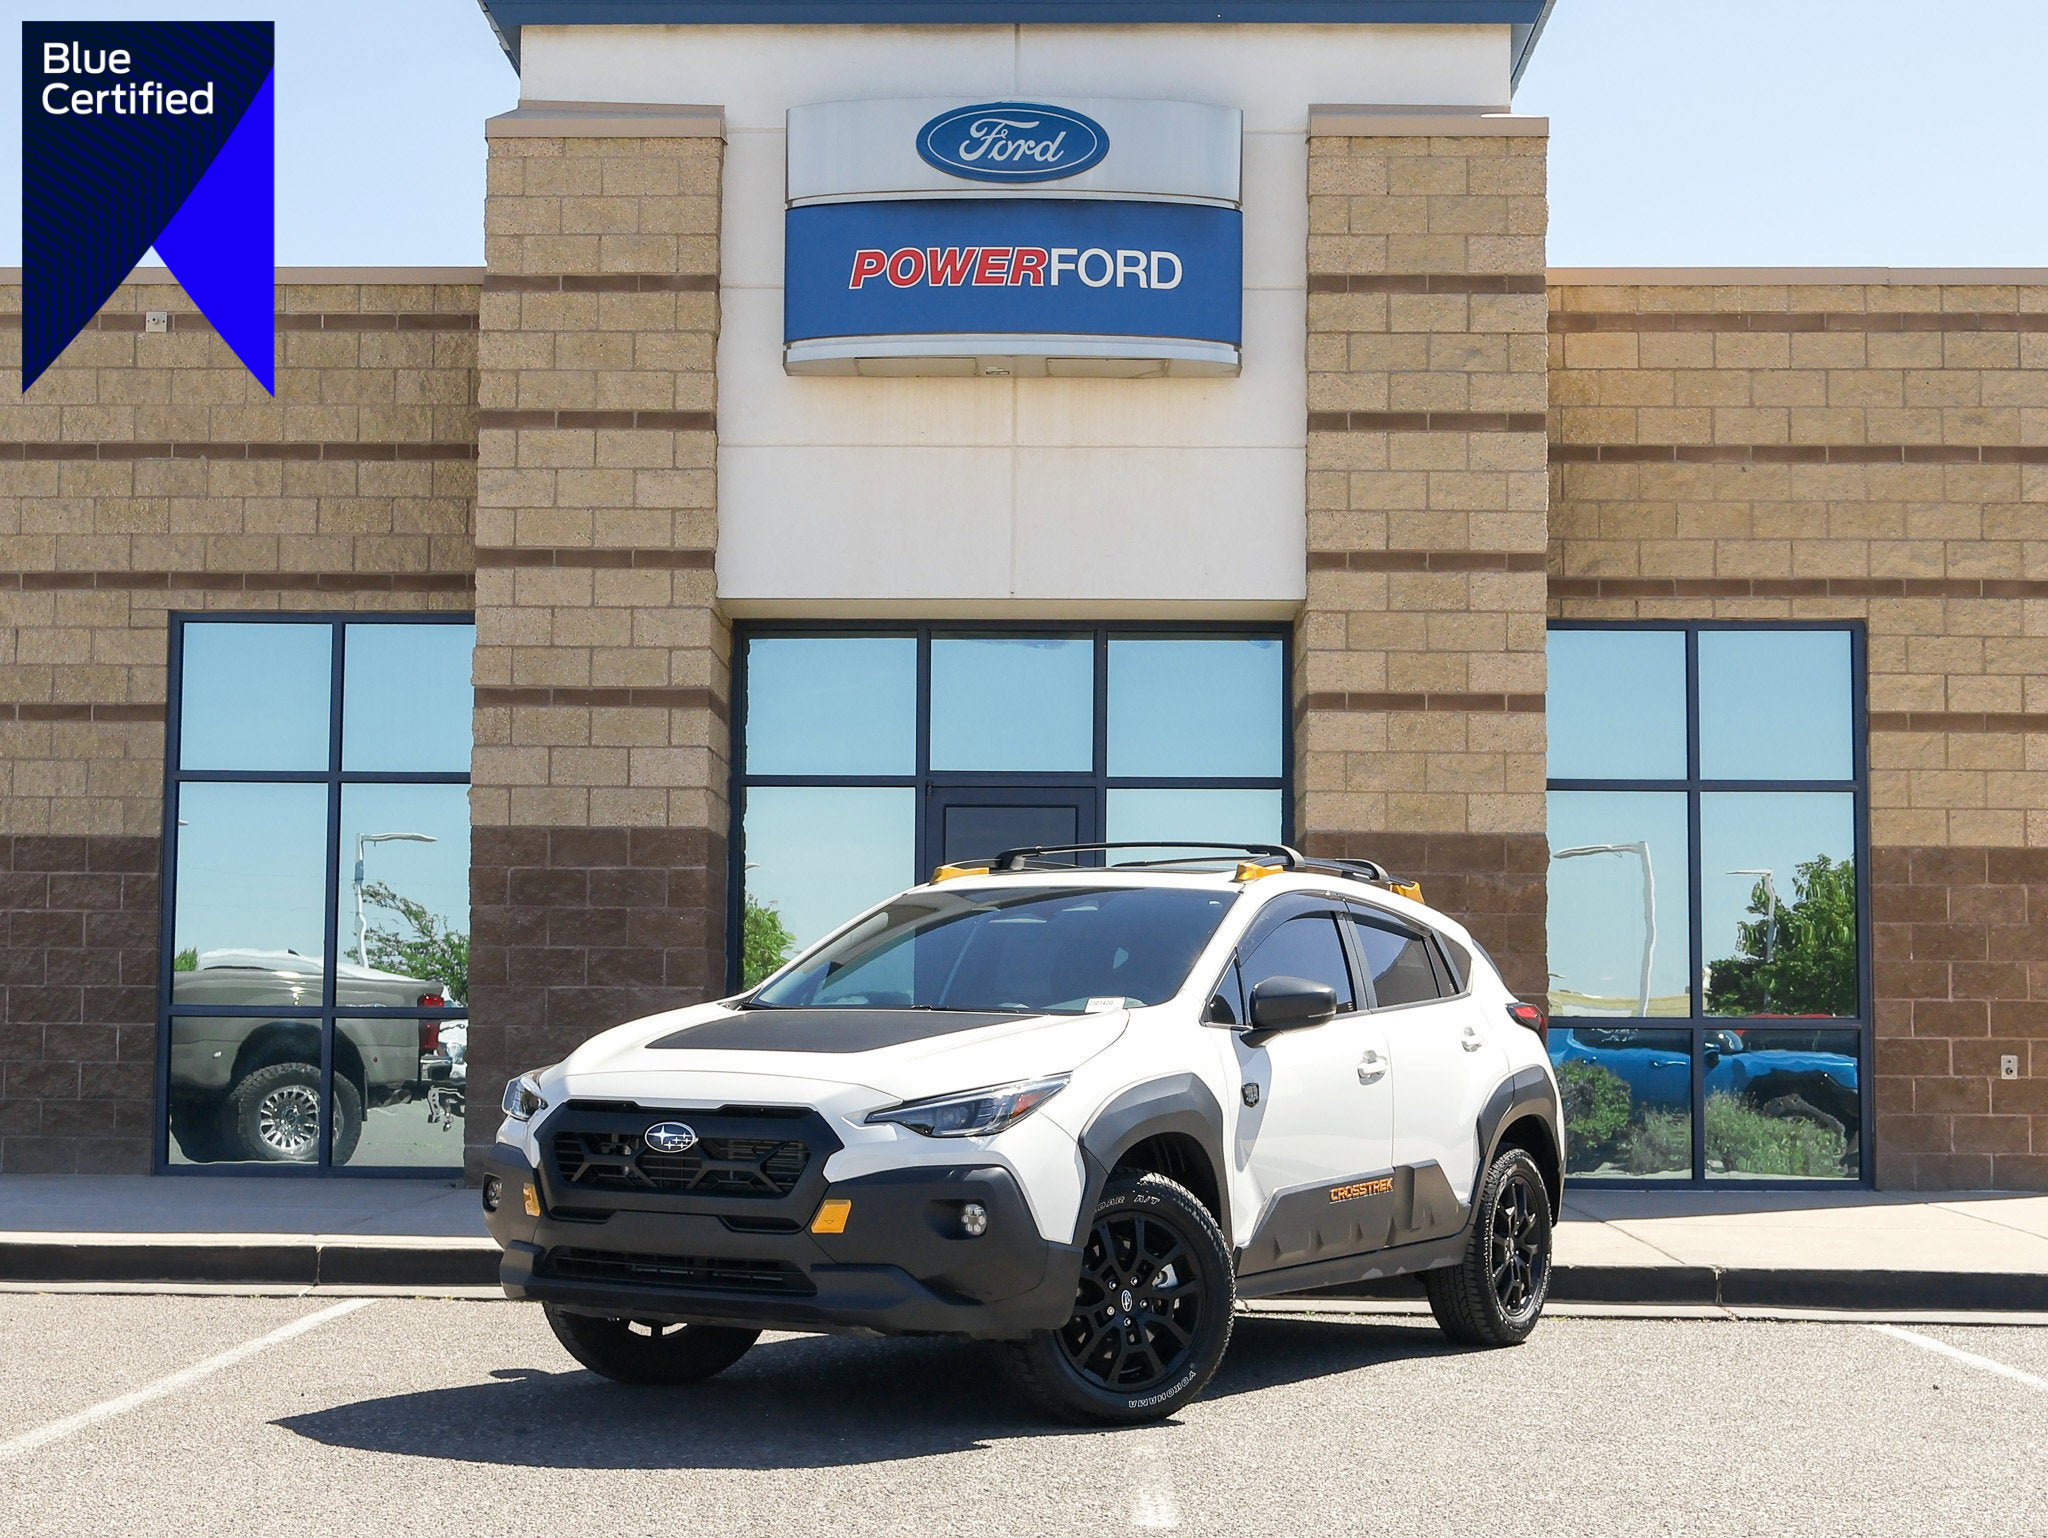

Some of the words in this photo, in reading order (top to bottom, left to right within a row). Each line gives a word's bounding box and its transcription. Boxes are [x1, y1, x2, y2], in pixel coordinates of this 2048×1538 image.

[959, 118, 1067, 162] Ford
[848, 246, 1184, 290] POWERFORD
[1094, 1195, 1126, 1213] DAR
[1133, 1194, 1161, 1205] A/T
[1329, 1177, 1394, 1202] CROSSTREK
[1128, 1370, 1197, 1408] YOKOHAMA
